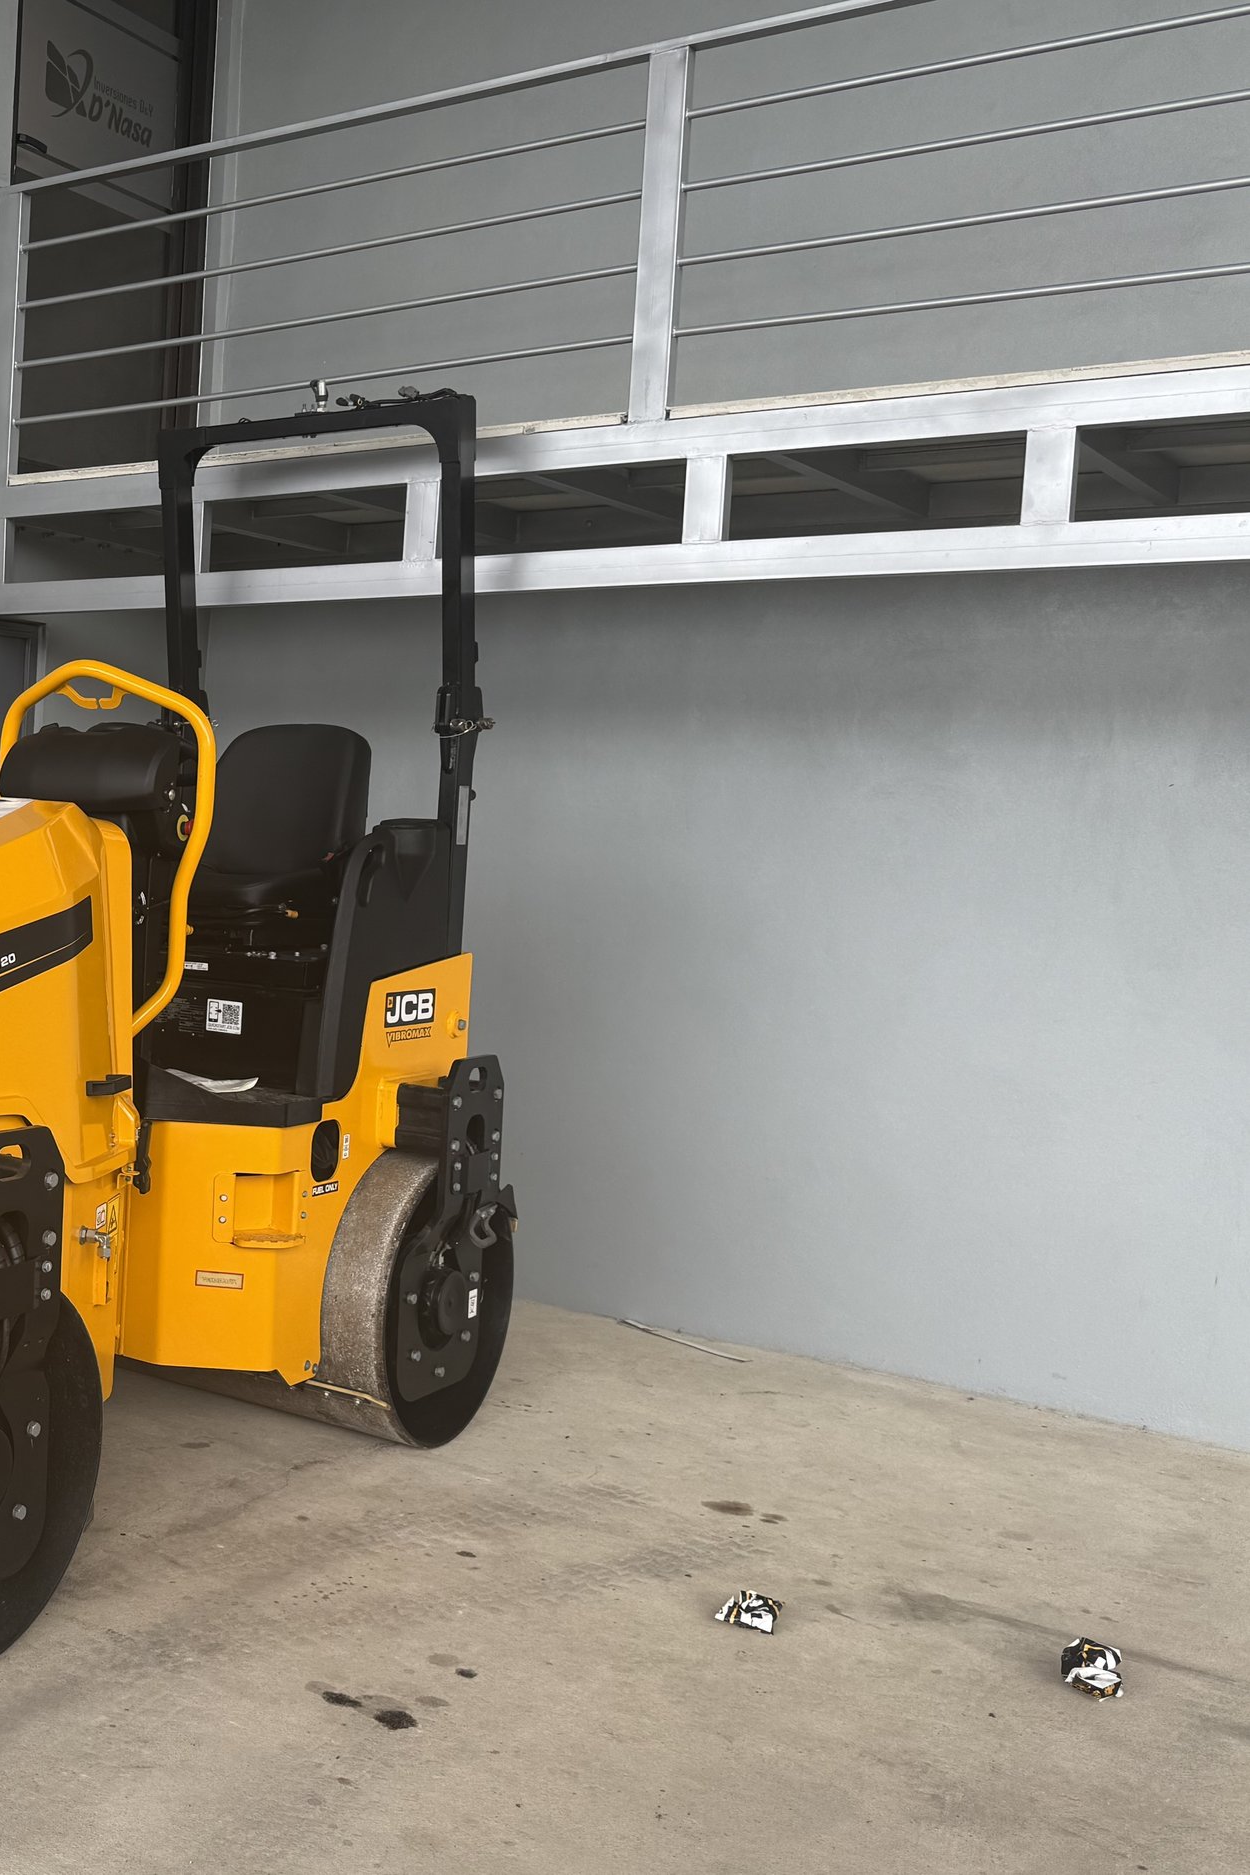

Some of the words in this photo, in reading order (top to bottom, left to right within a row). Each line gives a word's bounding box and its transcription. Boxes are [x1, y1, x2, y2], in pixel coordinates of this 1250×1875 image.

[386, 993, 433, 1023] JCB
[386, 1026, 431, 1048] VIBROMAX
[313, 1186, 324, 1195] FUEL
[325, 1183, 338, 1191] ONLY
